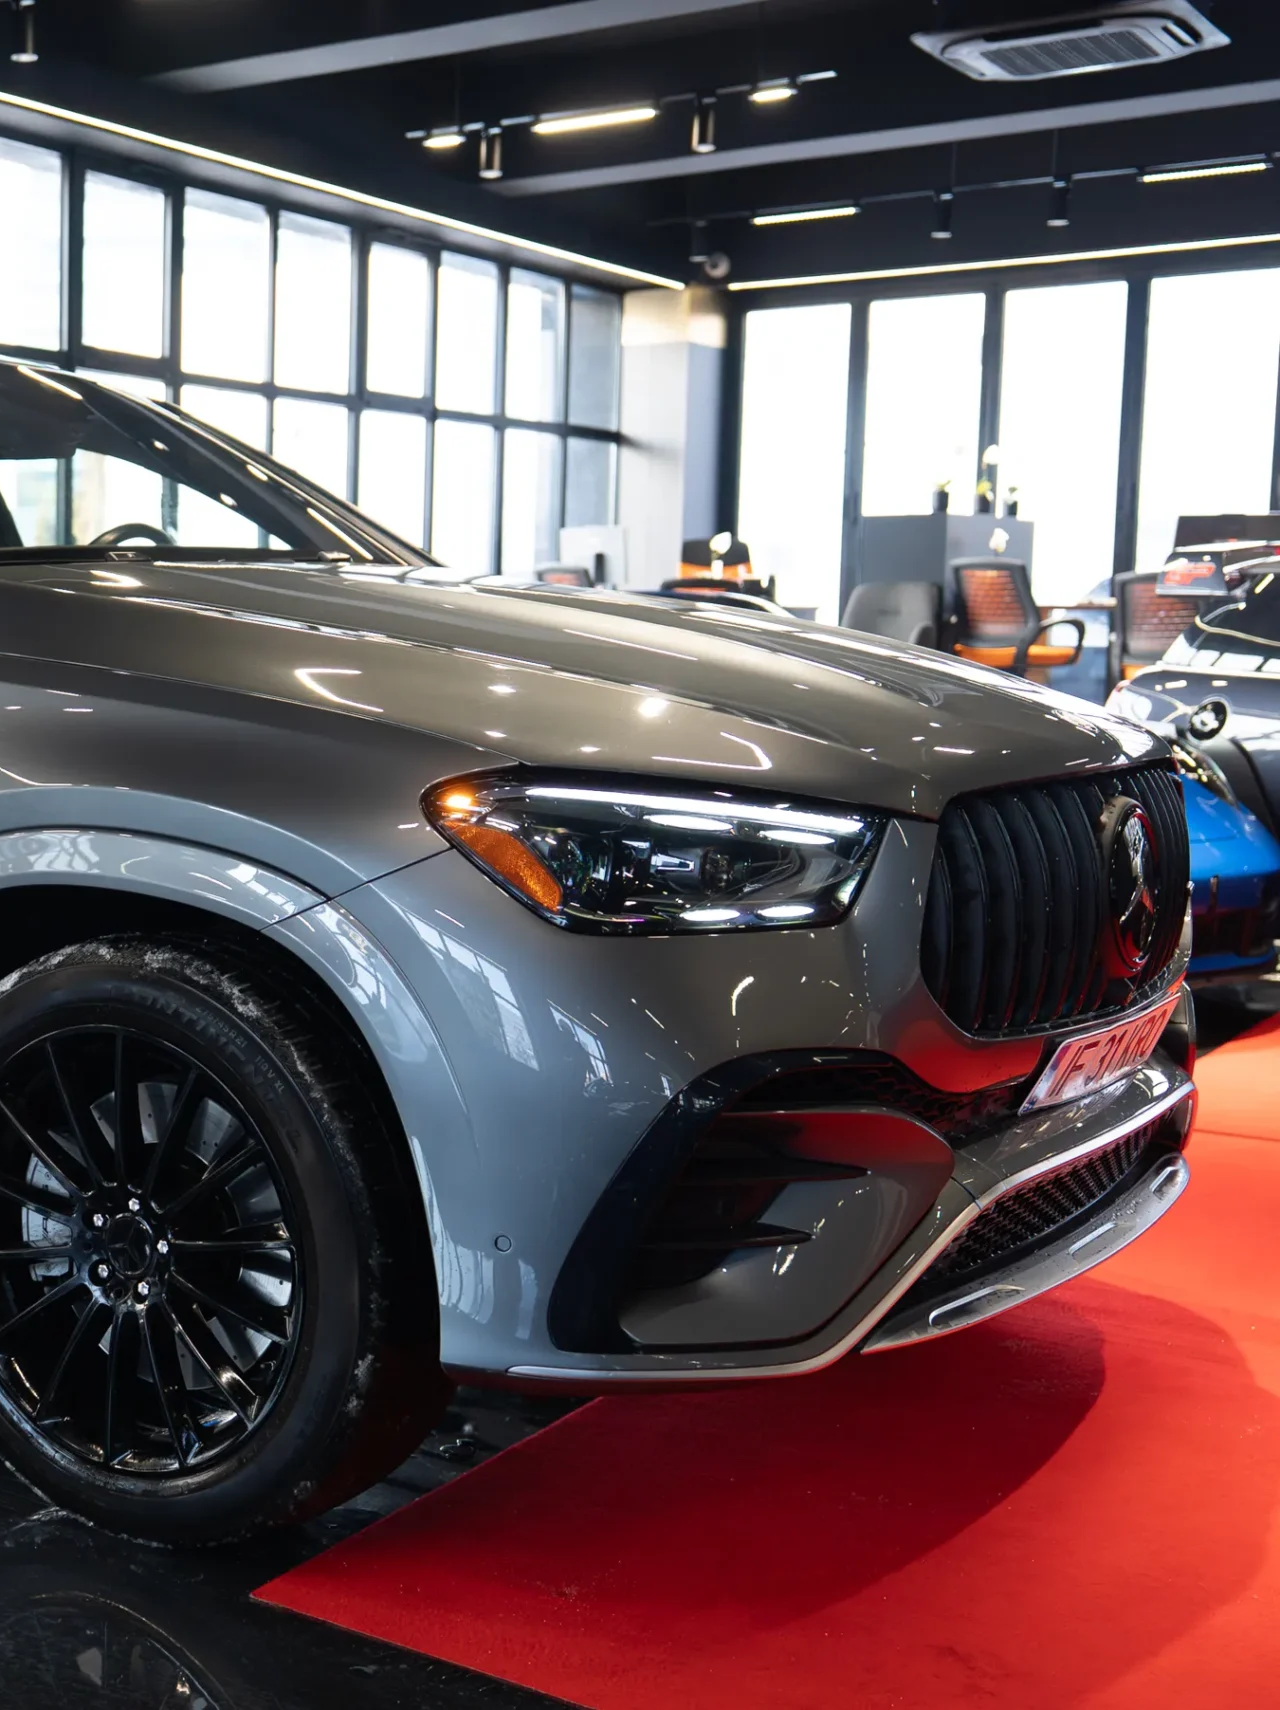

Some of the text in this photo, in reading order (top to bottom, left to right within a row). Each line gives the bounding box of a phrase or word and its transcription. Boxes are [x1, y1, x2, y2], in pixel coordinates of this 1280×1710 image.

[1048, 1008, 1167, 1097] IF 31 KRO
